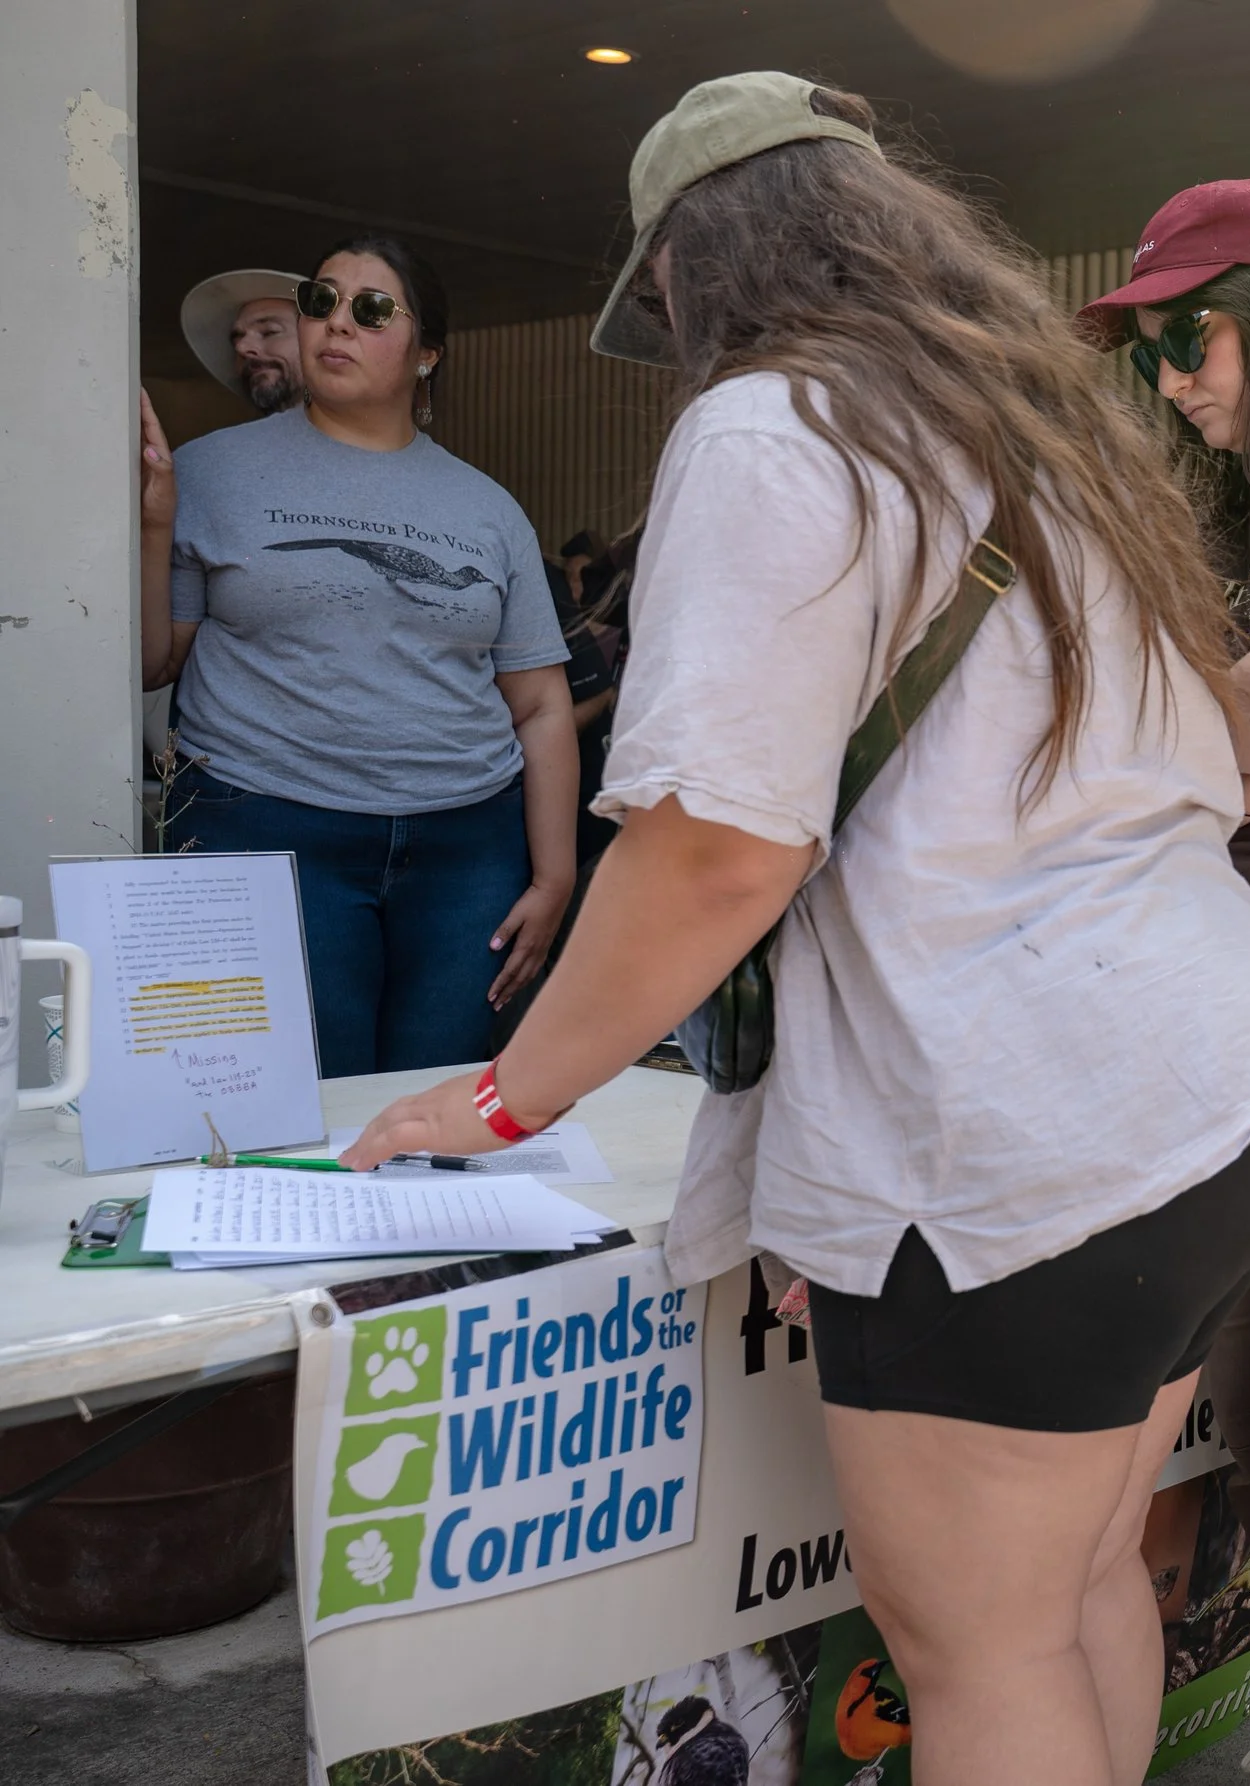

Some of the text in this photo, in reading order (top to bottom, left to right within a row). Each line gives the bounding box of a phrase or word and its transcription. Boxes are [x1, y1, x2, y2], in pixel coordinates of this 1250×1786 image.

[264, 508, 484, 557] THORNSCRUB POR VIDA
[188, 1052, 238, 1068] Missing
[659, 1287, 687, 1316] of
[659, 1314, 697, 1350] the
[452, 1275, 655, 1400] Friends
[447, 1362, 692, 1497] Wildlife
[429, 1467, 685, 1591] Corridor
[735, 1528, 853, 1614] Low
